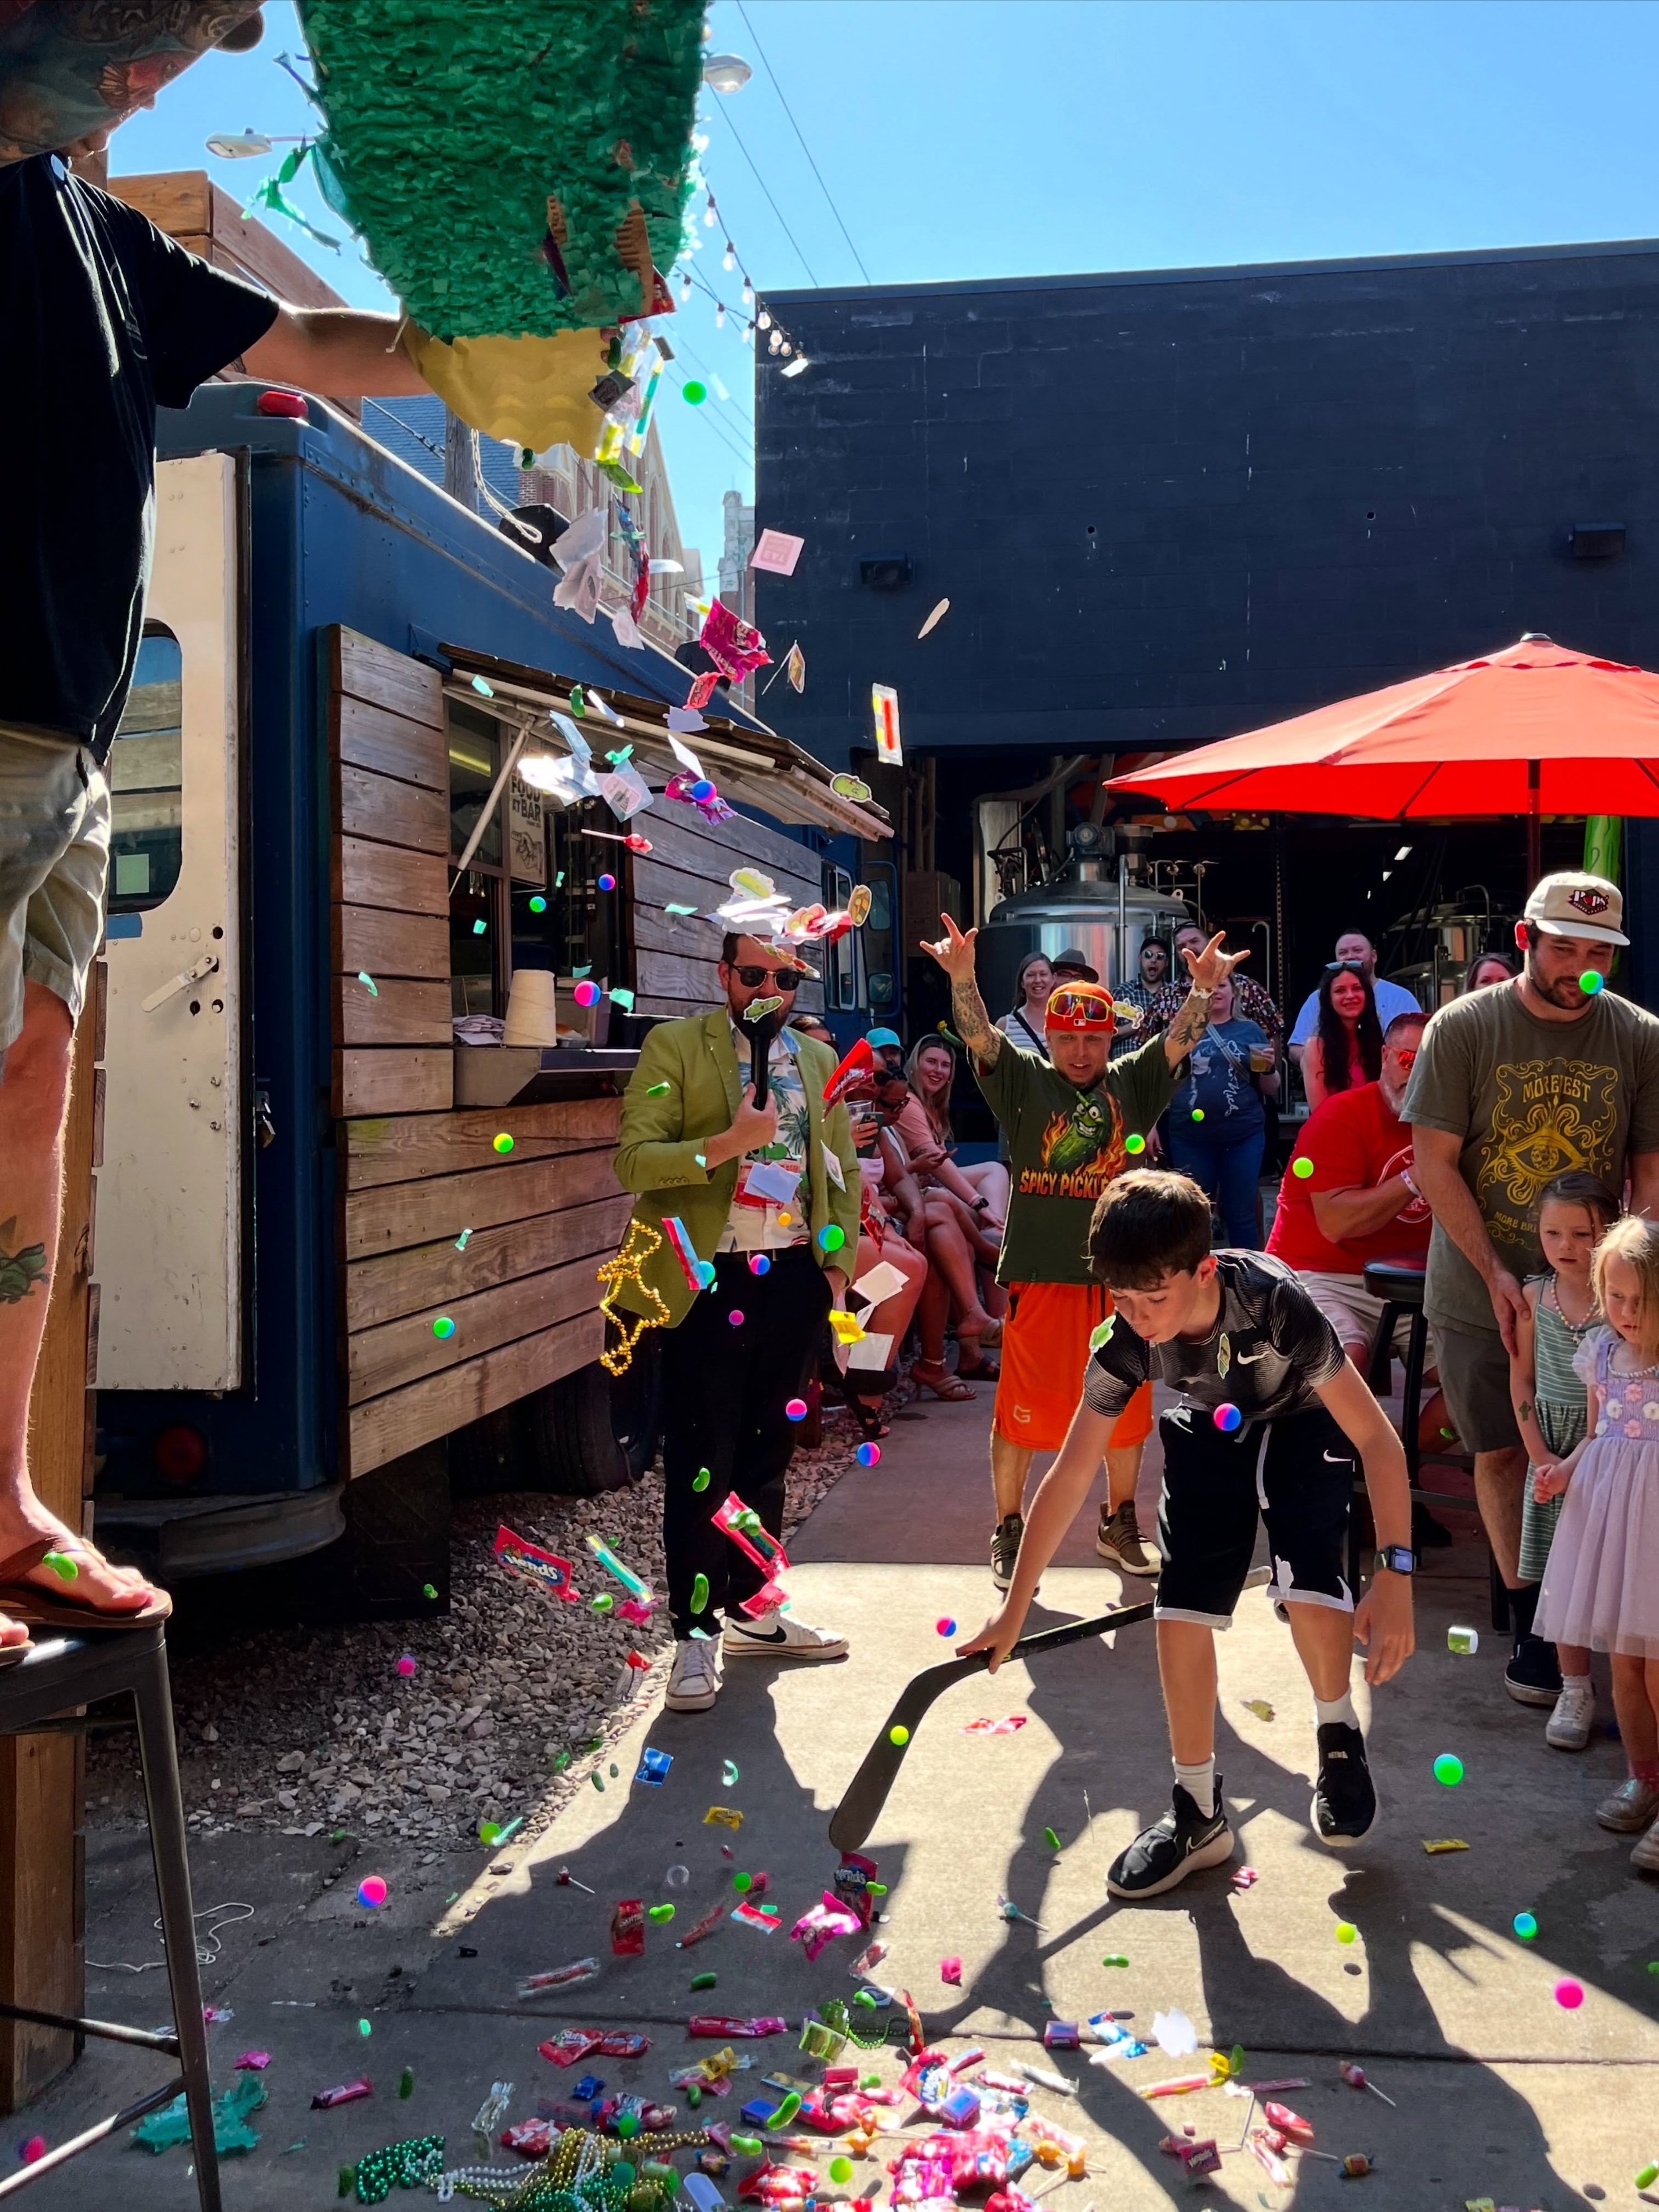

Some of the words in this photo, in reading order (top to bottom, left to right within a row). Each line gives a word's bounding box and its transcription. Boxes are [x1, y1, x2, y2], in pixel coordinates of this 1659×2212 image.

[521, 798, 541, 823] BAR
[1019, 1167, 1057, 1195] SPICY
[1494, 1211, 1519, 1228] MORE
